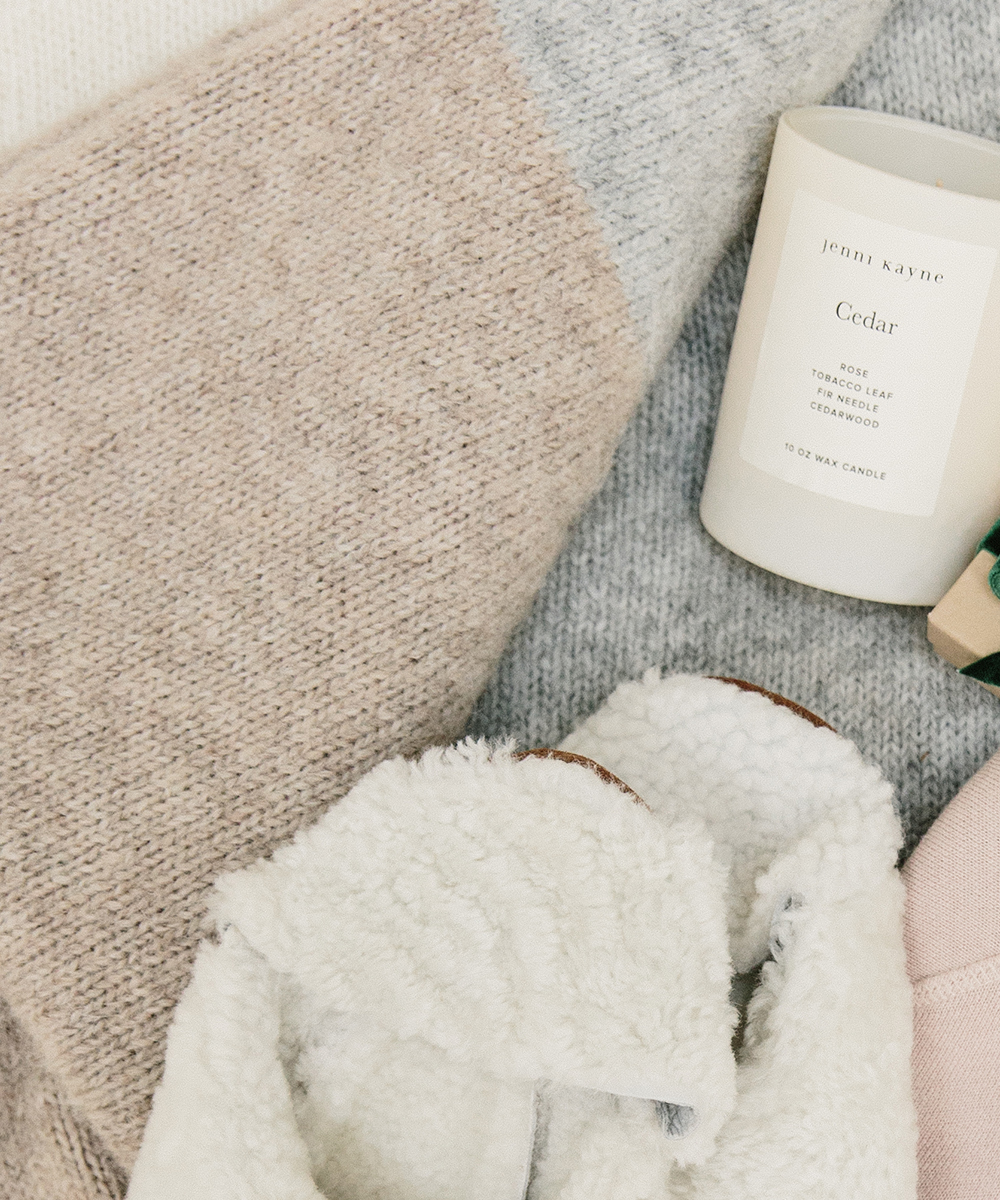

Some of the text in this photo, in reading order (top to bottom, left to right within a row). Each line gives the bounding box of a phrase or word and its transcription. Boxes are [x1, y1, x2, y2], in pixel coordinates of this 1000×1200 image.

[821, 239, 873, 265] jenni
[836, 301, 898, 334] Cedar
[812, 369, 894, 400] TOBACCO LEAF
[840, 363, 869, 378] ROSE
[817, 387, 879, 413] FIR NEEDLE
[810, 401, 880, 429] CEDARWOOD
[784, 442, 887, 480] 10 OZ WAX CANDLE
